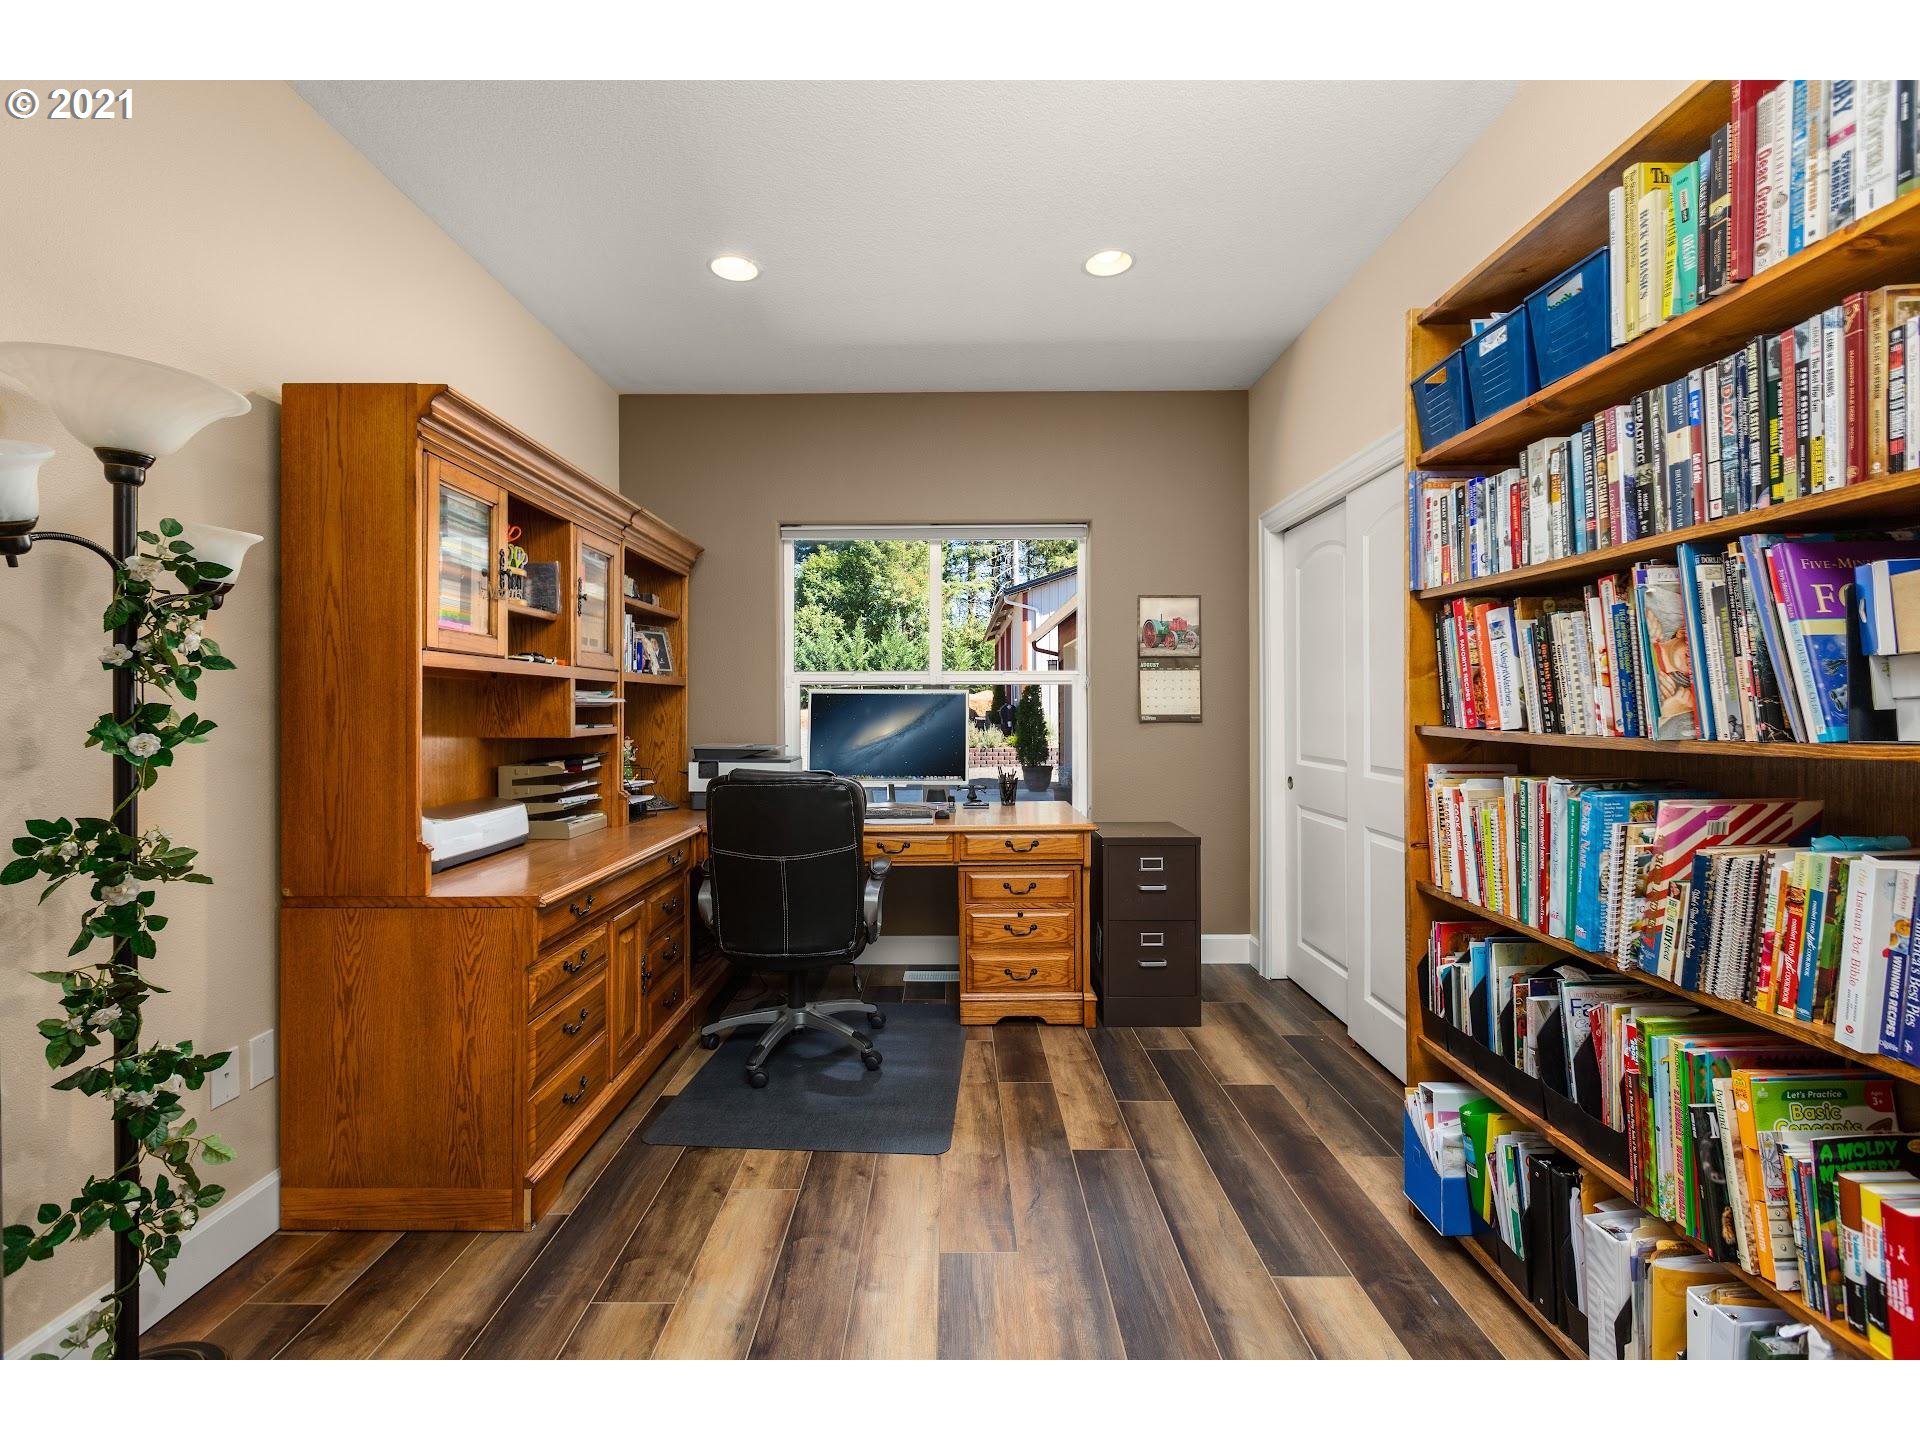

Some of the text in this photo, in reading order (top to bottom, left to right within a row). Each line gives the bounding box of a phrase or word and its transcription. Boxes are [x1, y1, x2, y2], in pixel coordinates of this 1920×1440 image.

[1650, 168, 1670, 184] Th
[1757, 147, 1773, 185] Dean
[1841, 150, 1851, 200] STEPHEN
[1831, 159, 1841, 213] AMBROSE
[1699, 208, 1707, 227] WAY
[1756, 185, 1772, 242] Graziosi
[1639, 210, 1650, 300] BACK TO BASICS
[1682, 233, 1696, 272] OREGON
[1749, 369, 1758, 391] FROM
[1749, 392, 1759, 411] REAL
[1783, 367, 1793, 423] BEDFORD
[1721, 383, 1735, 436] D-DAY
[1634, 416, 1644, 463] PACIFIC
[1750, 412, 1760, 441] ESTATE
[1769, 418, 1778, 445] DONALD
[1786, 425, 1794, 450] BOYS
[1750, 441, 1760, 463] RIGHT
[1770, 453, 1779, 478] MILLER
[1583, 432, 1594, 519] THE LONGEST WINTER
[1595, 424, 1608, 520] HUNTING EICHMANN
[1701, 556, 1723, 564] DORLIN
[1723, 624, 1732, 657] SECRETS
[1794, 639, 1806, 665] FOUR
[1459, 639, 1471, 702] FAVORITE RECIPES
[1541, 643, 1551, 680] One-Dish
[1481, 666, 1490, 710] COOKBOOK
[1545, 680, 1553, 703] Meals
[1559, 664, 1567, 698] Cookbook
[1579, 800, 1592, 868] BRAND NAME
[1767, 893, 1778, 915] JUICE
[1854, 890, 1867, 932] Instant
[1664, 925, 1674, 944] GUY
[1789, 919, 1798, 940] comfort
[1806, 932, 1816, 950] diet
[1851, 935, 1863, 955] Pot
[1784, 954, 1797, 974] diet
[1804, 949, 1813, 976] COOKBOOK
[1848, 958, 1861, 987] Bible
[1782, 972, 1791, 1003] COOKBOOK
[1886, 956, 1902, 1038] WINNING RECIPES
[1908, 976, 1920, 1002] Best
[1905, 1004, 1918, 1028] Pies
[1787, 1090, 1842, 1099] Let's Practice
[1872, 1097, 1883, 1106] 3+
[1715, 1089, 1729, 1131] Portland
[1789, 1102, 1842, 1121] Basic
[1774, 1118, 1863, 1132] Concepts
[1820, 1140, 1899, 1163] A MOLDY
[1677, 1178, 1686, 1220] ANIMALS
[1854, 1261, 1862, 1277] Society
